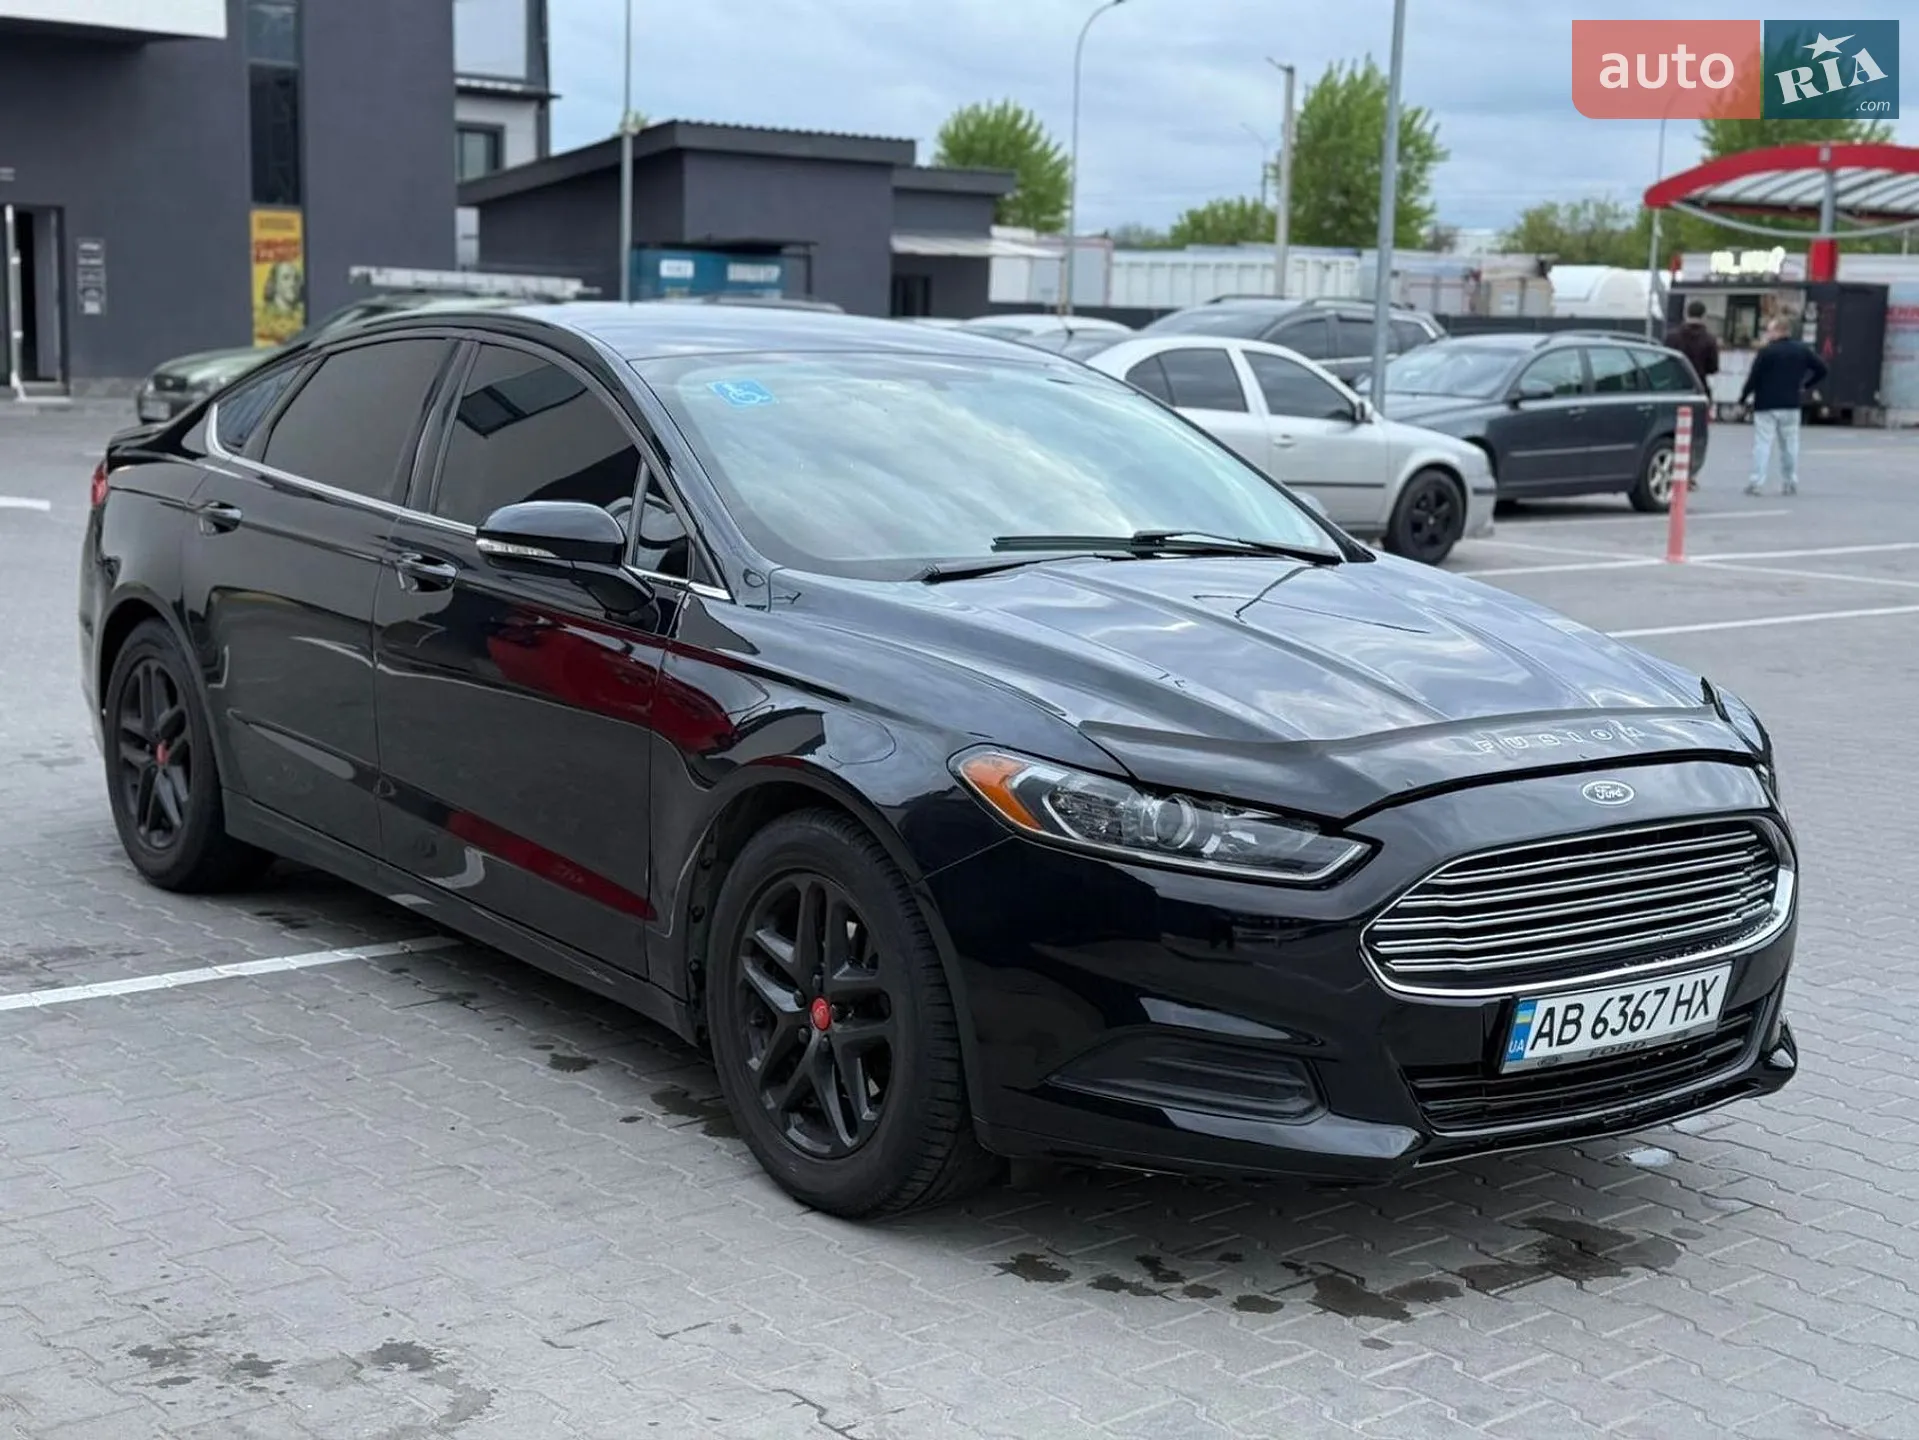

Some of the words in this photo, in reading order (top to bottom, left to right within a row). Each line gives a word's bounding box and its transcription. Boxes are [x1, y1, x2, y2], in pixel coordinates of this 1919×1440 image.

[1530, 1003, 1585, 1051] AB
[1590, 986, 1671, 1040] 6367
[1669, 974, 1720, 1026] HX
[1508, 1038, 1525, 1053] UA
